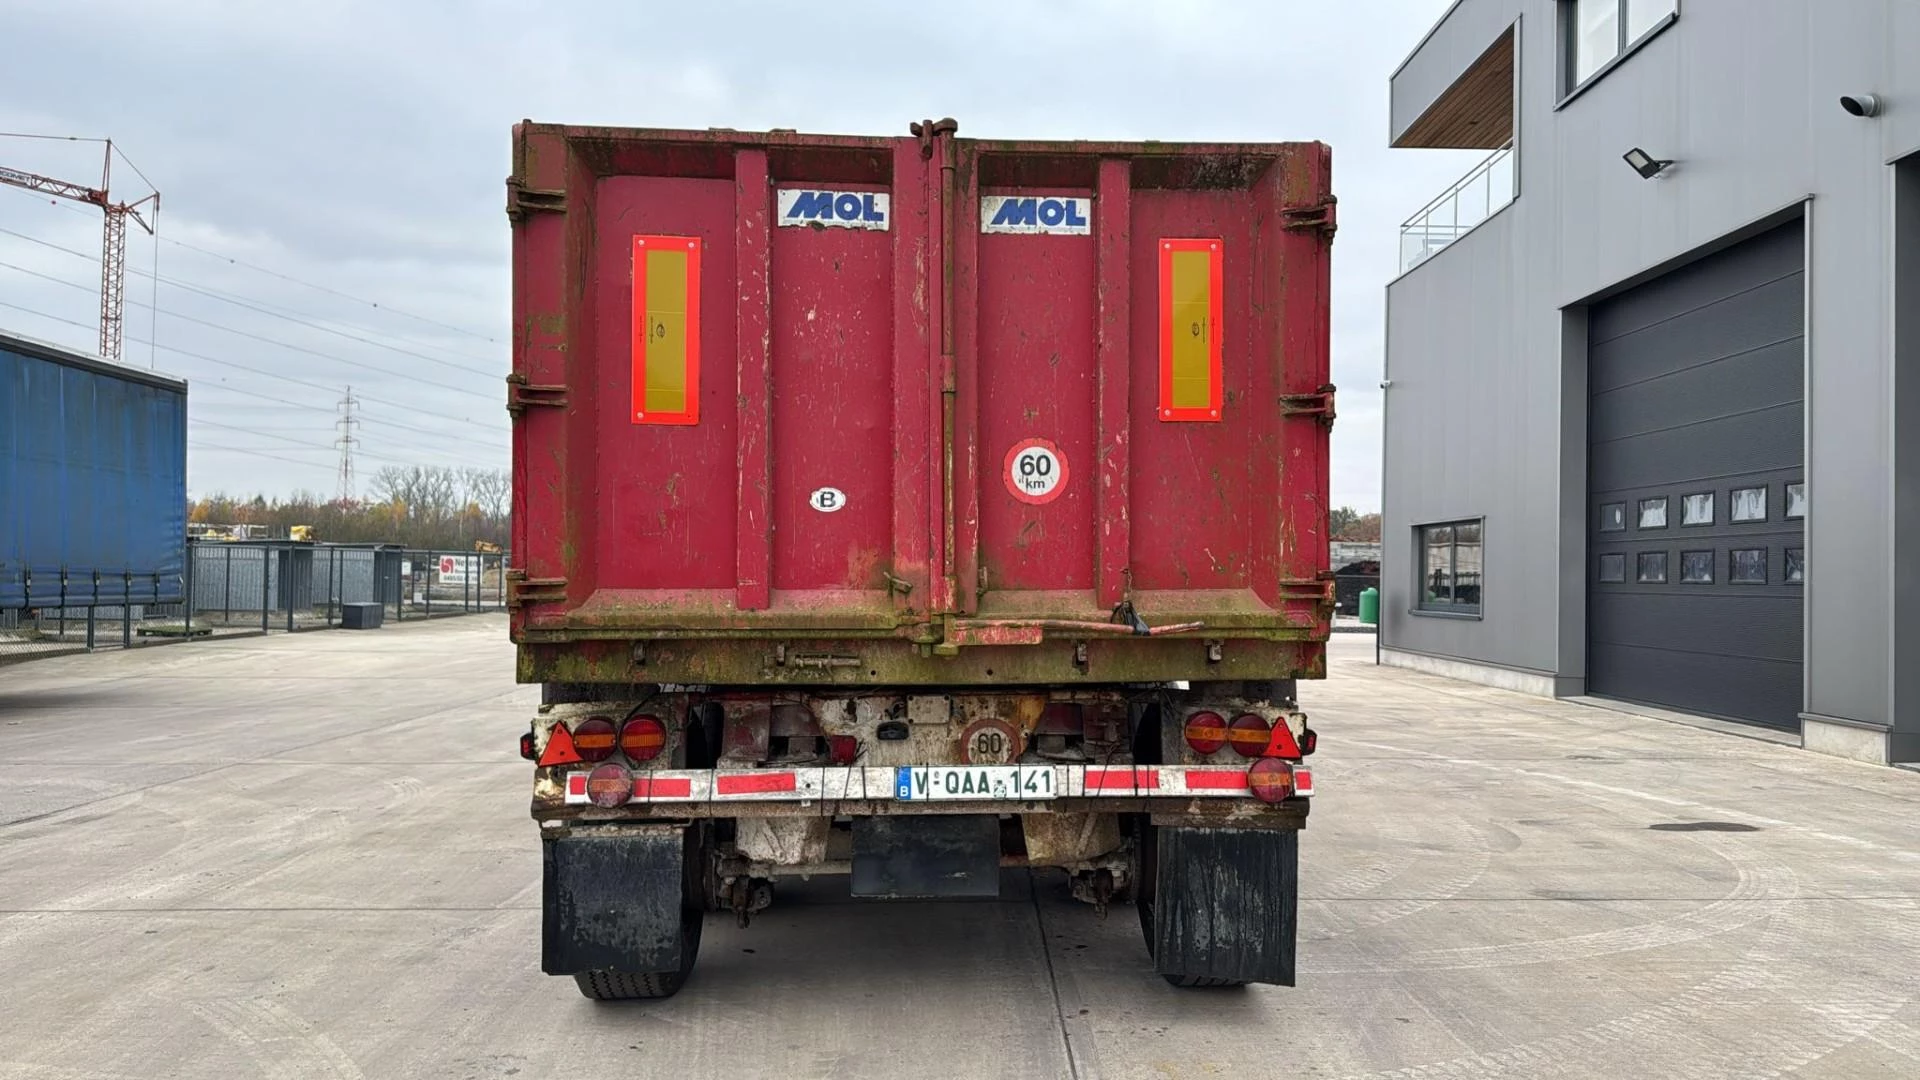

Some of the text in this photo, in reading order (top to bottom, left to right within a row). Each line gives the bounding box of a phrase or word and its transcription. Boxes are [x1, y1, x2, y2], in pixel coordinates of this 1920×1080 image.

[786, 191, 884, 221] MOL
[990, 198, 1086, 226] MOL
[1019, 454, 1051, 476] 60
[1025, 477, 1045, 489] km
[820, 491, 836, 507] B
[977, 732, 1002, 754] 60
[900, 785, 909, 797] B
